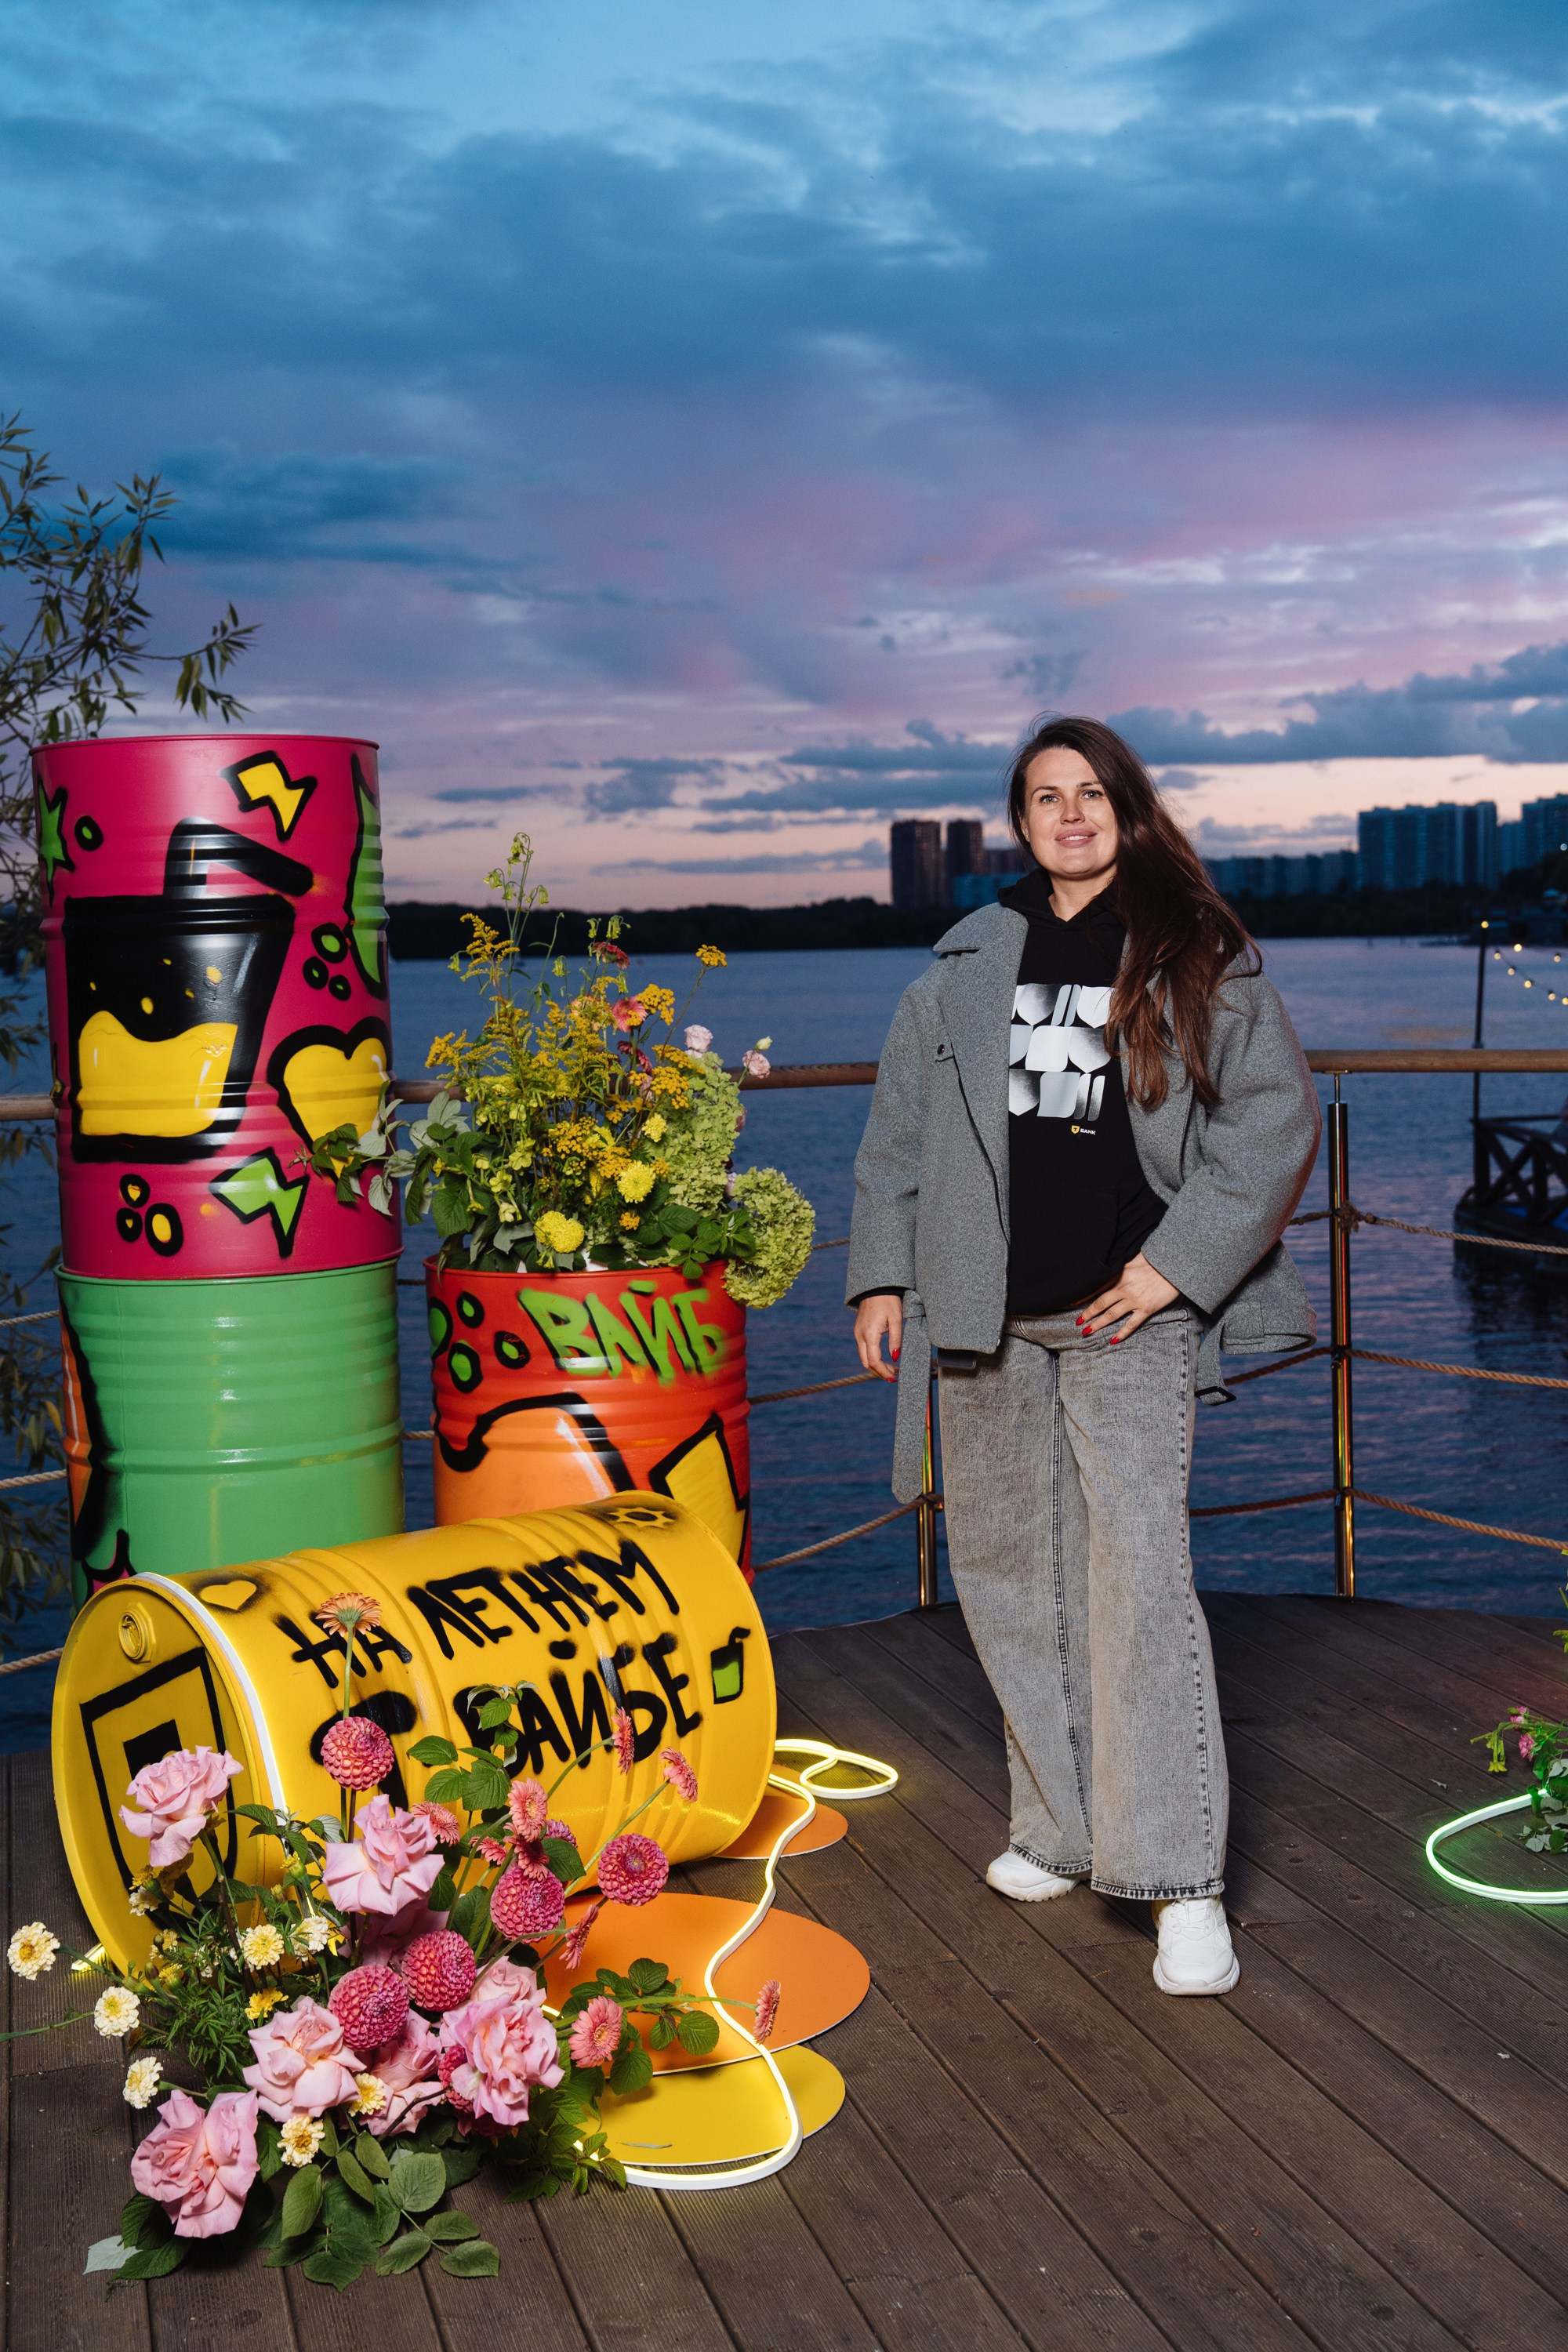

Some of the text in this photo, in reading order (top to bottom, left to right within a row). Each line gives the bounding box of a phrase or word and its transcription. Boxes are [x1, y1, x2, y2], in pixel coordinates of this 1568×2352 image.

[1080, 1127, 1096, 1136] БАНК
[517, 1279, 727, 1386] ВАЙБ
[272, 1539, 681, 1689] НА ЛЕТНЕМ
